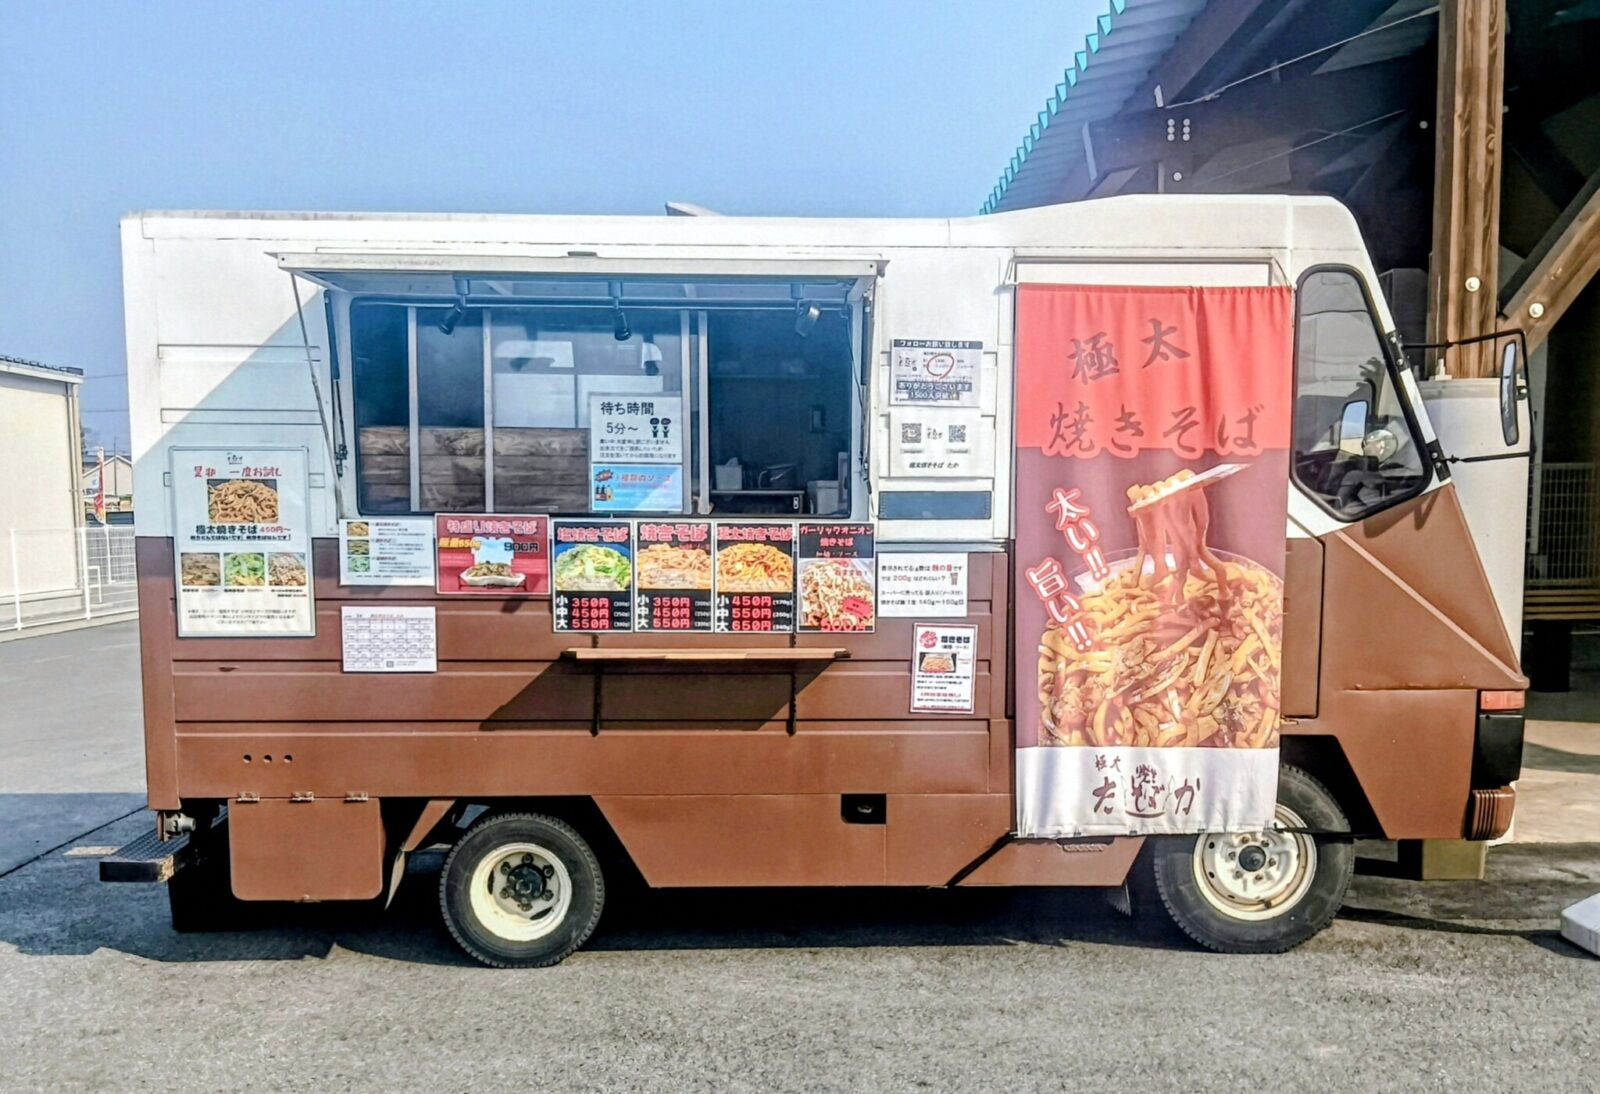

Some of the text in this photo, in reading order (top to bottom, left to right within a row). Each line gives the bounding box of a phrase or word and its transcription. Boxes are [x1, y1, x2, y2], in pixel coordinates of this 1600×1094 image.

[600, 402, 654, 415] 待ち時間
[1049, 401, 1265, 453] 焼きそば
[640, 524, 708, 542] 焼きそば
[556, 595, 568, 606] 小
[571, 597, 609, 606] 350円
[638, 595, 650, 606] 小
[653, 597, 690, 606] 350円
[717, 596, 728, 606] 小
[732, 596, 772, 606] 450円
[556, 607, 568, 616] 中
[638, 607, 650, 616] 中
[717, 608, 728, 618] 中
[732, 608, 772, 618] 550円
[556, 618, 568, 628] 大
[571, 620, 609, 628] 550円
[638, 618, 650, 628] 大
[653, 620, 690, 628] 550円
[717, 621, 728, 631] 大
[732, 620, 772, 630] 650円
